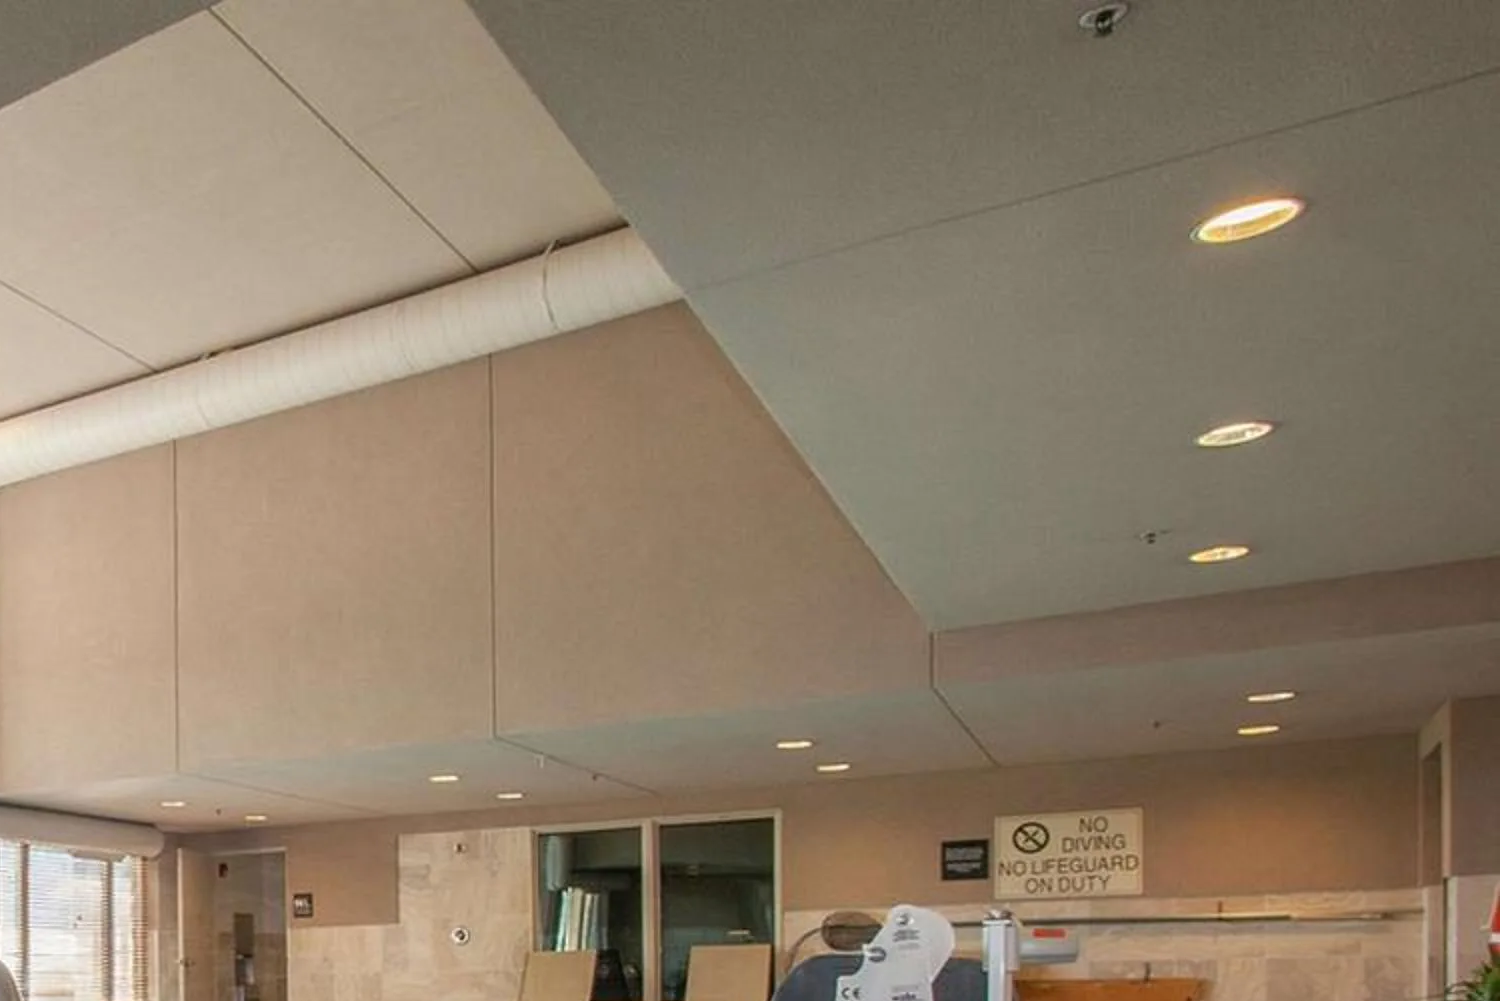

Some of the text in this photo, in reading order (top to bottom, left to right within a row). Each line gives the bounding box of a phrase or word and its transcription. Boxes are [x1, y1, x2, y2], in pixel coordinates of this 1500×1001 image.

[1079, 816, 1108, 833] NO
[1062, 834, 1126, 853] DIVING
[998, 854, 1140, 877] NO LIFEGUARD
[1025, 874, 1112, 894] ON DUTY
